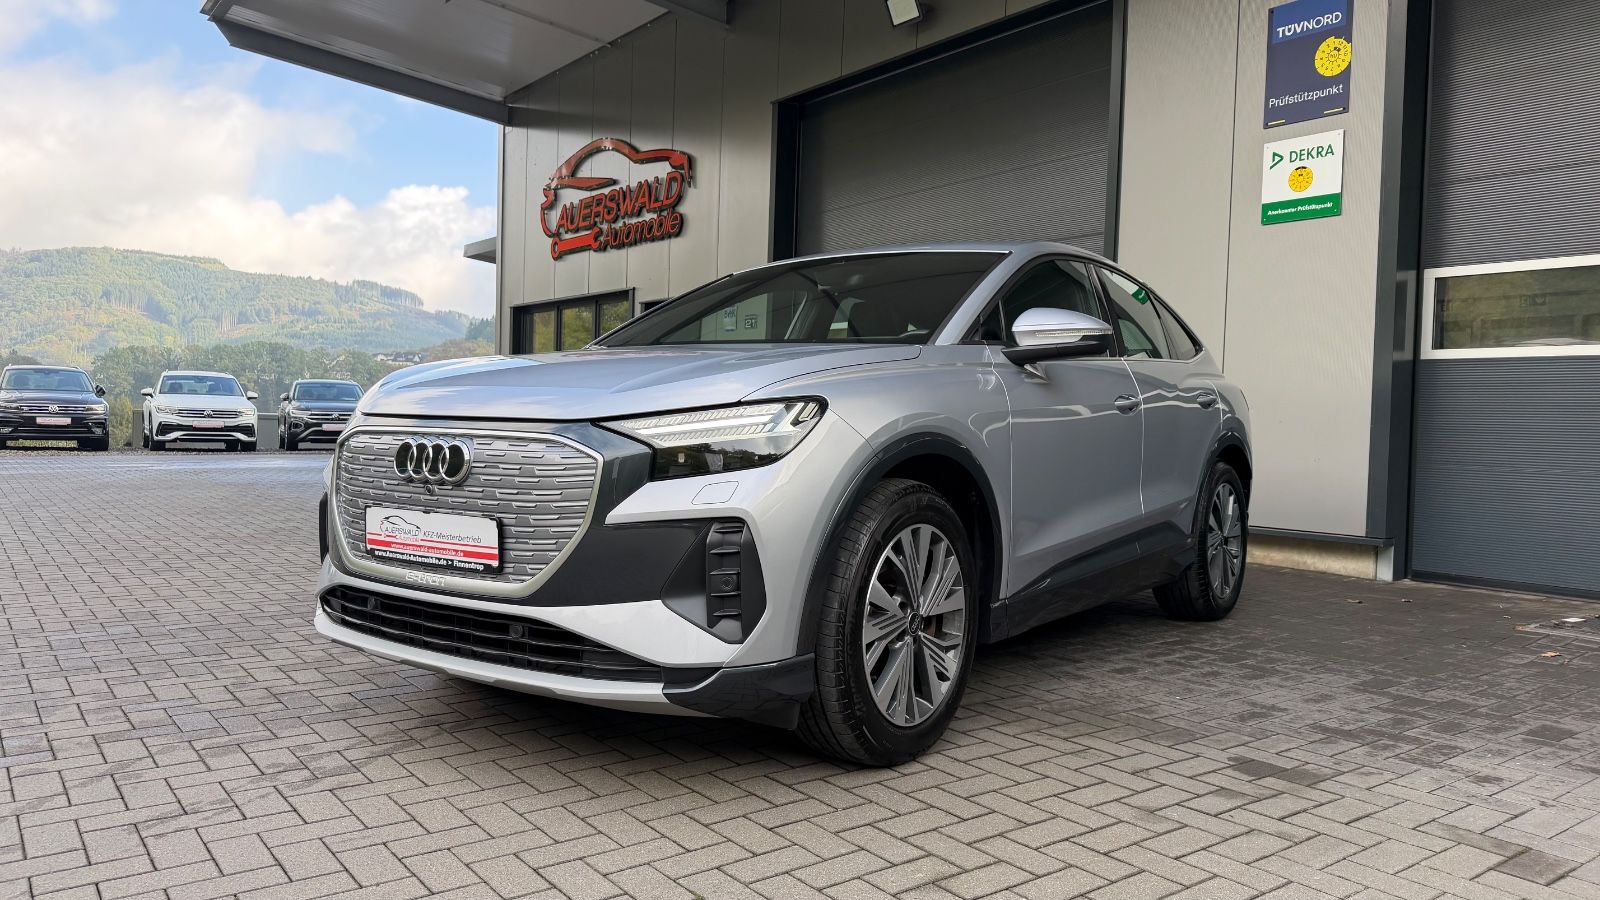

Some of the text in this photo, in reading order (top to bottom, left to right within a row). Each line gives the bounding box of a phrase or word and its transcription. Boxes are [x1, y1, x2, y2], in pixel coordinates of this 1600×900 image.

[1269, 83, 1343, 108] Prüfstützpunkt
[1289, 144, 1335, 163] DEKRA
[555, 171, 684, 235] AUERSWALD
[602, 209, 683, 249] Automobile
[423, 530, 482, 544] KFZ-Meisterbetrieb
[453, 559, 484, 572] Finnentrop
